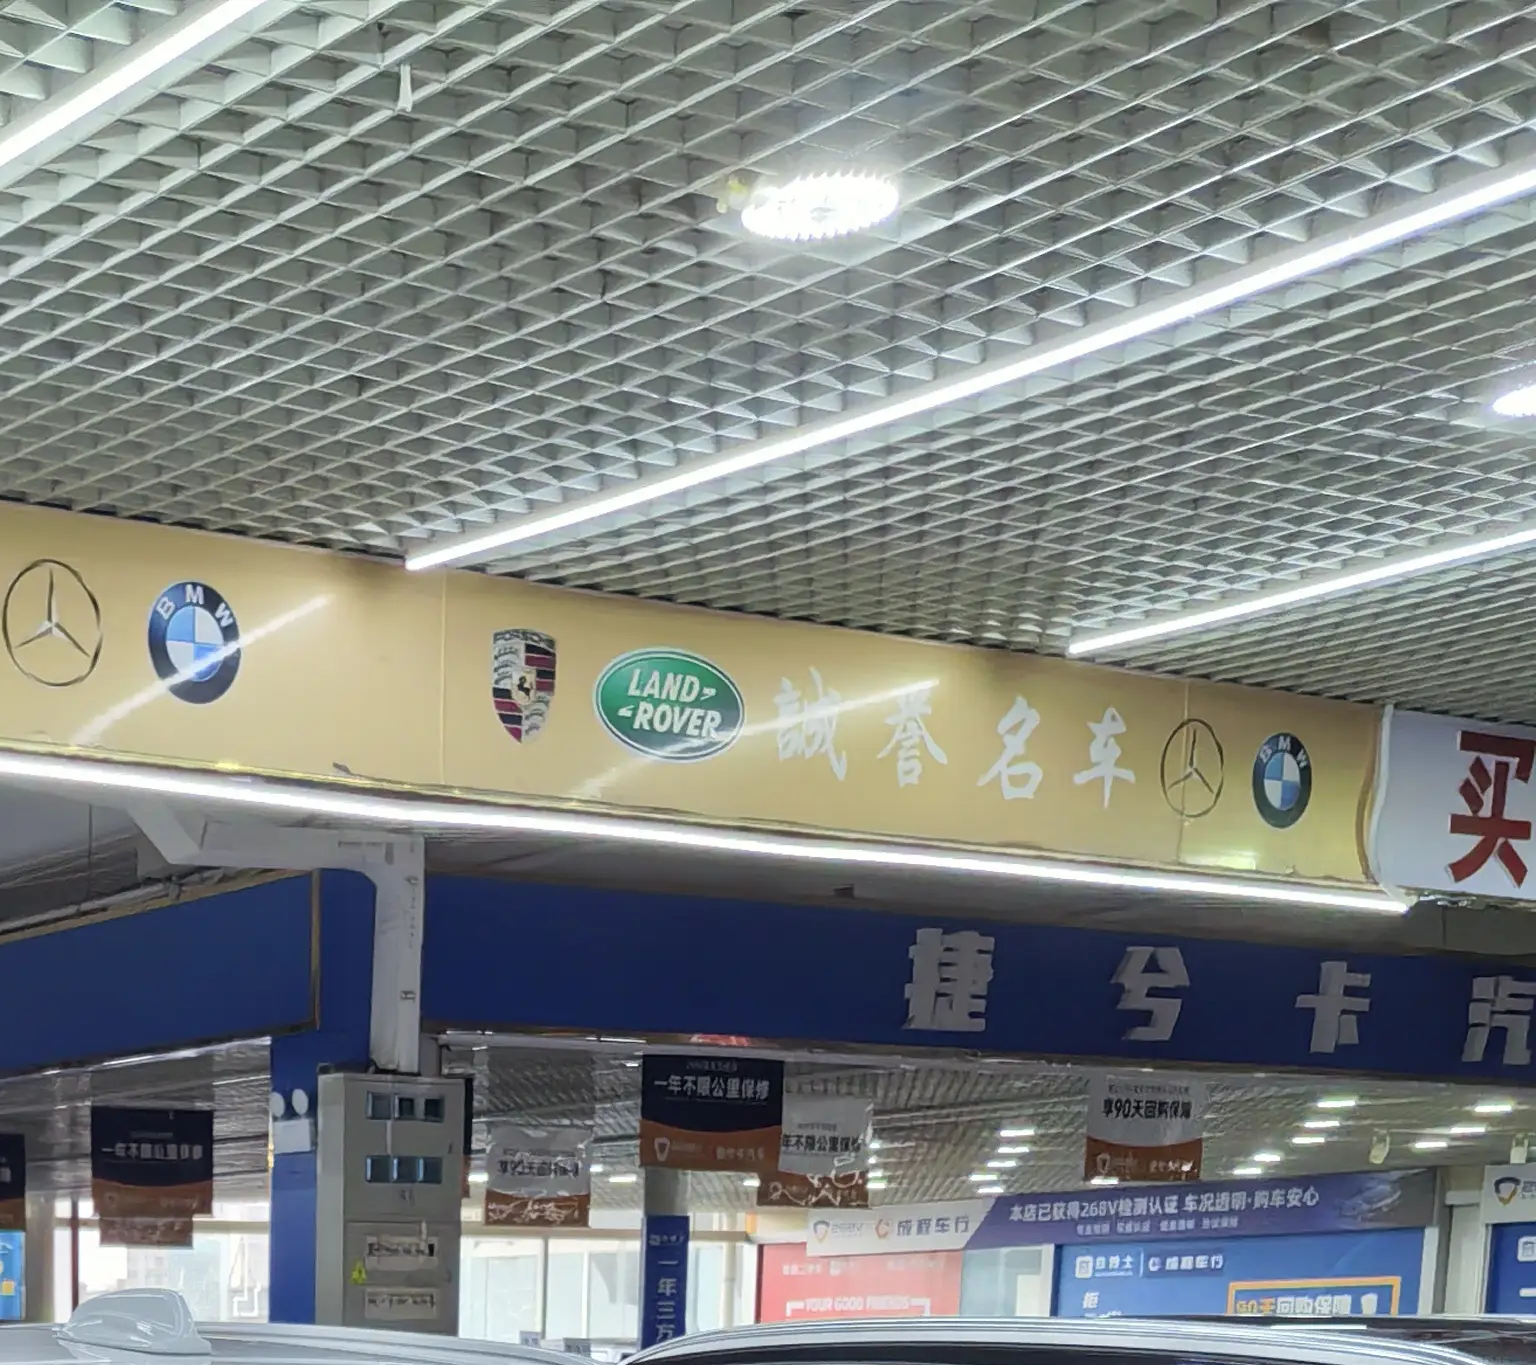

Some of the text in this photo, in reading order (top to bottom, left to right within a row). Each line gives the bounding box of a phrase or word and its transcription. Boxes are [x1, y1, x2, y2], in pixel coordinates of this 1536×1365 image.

[155, 584, 235, 628] BMW
[628, 668, 700, 701] LAND
[633, 704, 722, 739] ROVER
[654, 1074, 770, 1100] 一年不限公里保修
